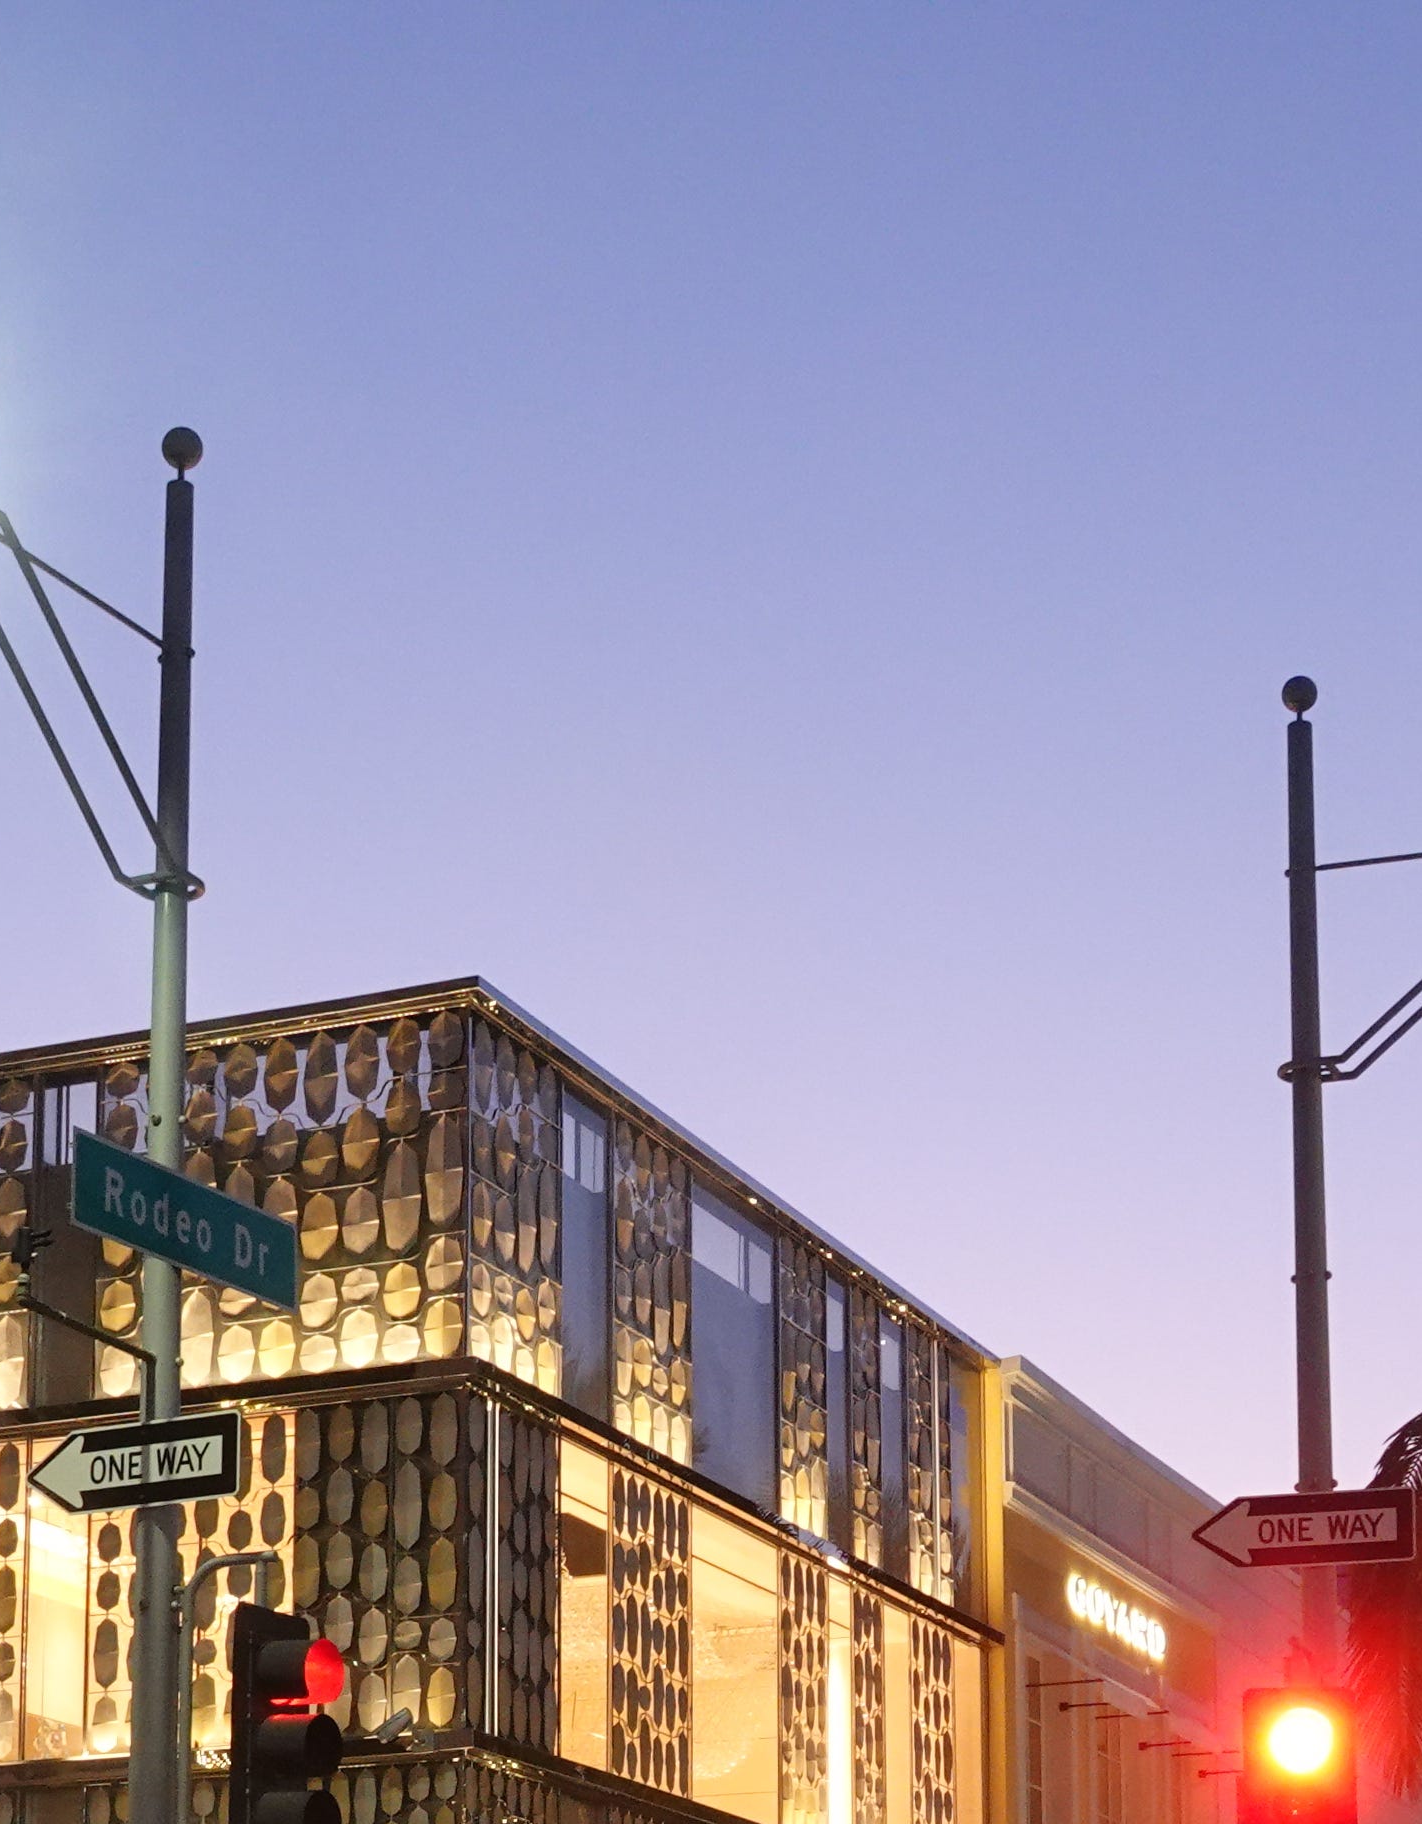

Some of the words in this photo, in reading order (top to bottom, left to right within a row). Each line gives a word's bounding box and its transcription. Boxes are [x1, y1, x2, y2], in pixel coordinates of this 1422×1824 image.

[104, 1166, 212, 1253] Rodeo
[234, 1223, 269, 1276] Dr
[90, 1450, 142, 1485] ONE
[156, 1441, 211, 1477] WAY
[1258, 1517, 1313, 1544] ONE
[1328, 1512, 1384, 1540] WAY
[1067, 1574, 1167, 1661] GOYARD
